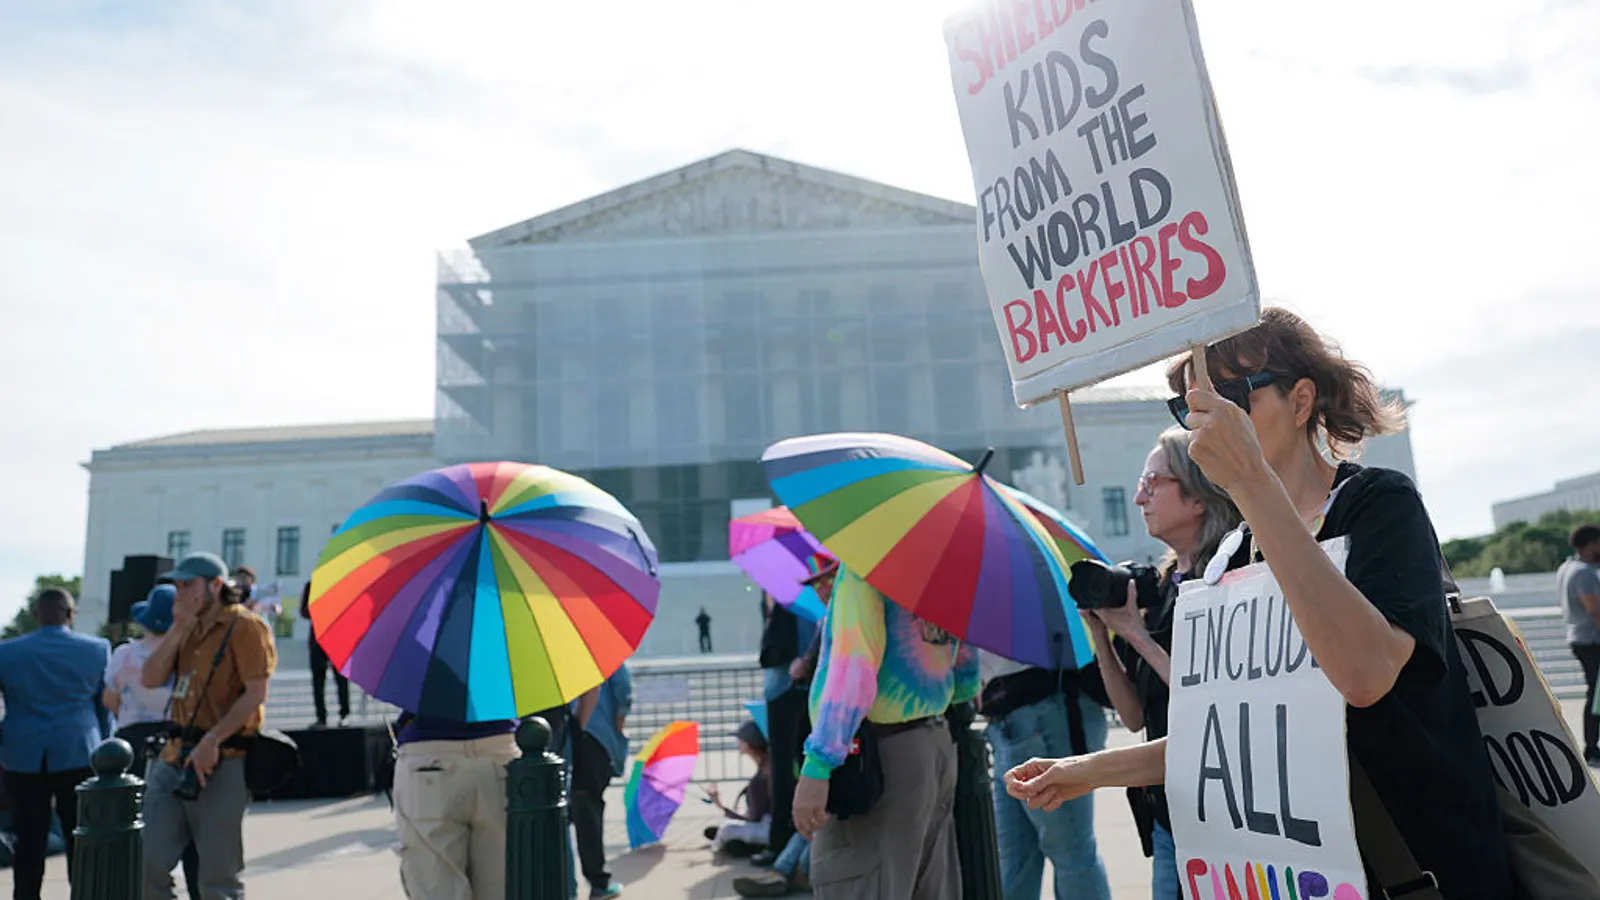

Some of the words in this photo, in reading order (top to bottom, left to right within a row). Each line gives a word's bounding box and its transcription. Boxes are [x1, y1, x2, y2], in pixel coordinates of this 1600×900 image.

[1003, 20, 1119, 149] KIDS
[981, 149, 1073, 242] FROM
[1077, 84, 1157, 174] THE
[1007, 168, 1172, 289] WORLD
[1004, 211, 1226, 363] BACKFIRES
[1181, 596, 1321, 687] INCLUD
[1198, 702, 1322, 847] ALL
